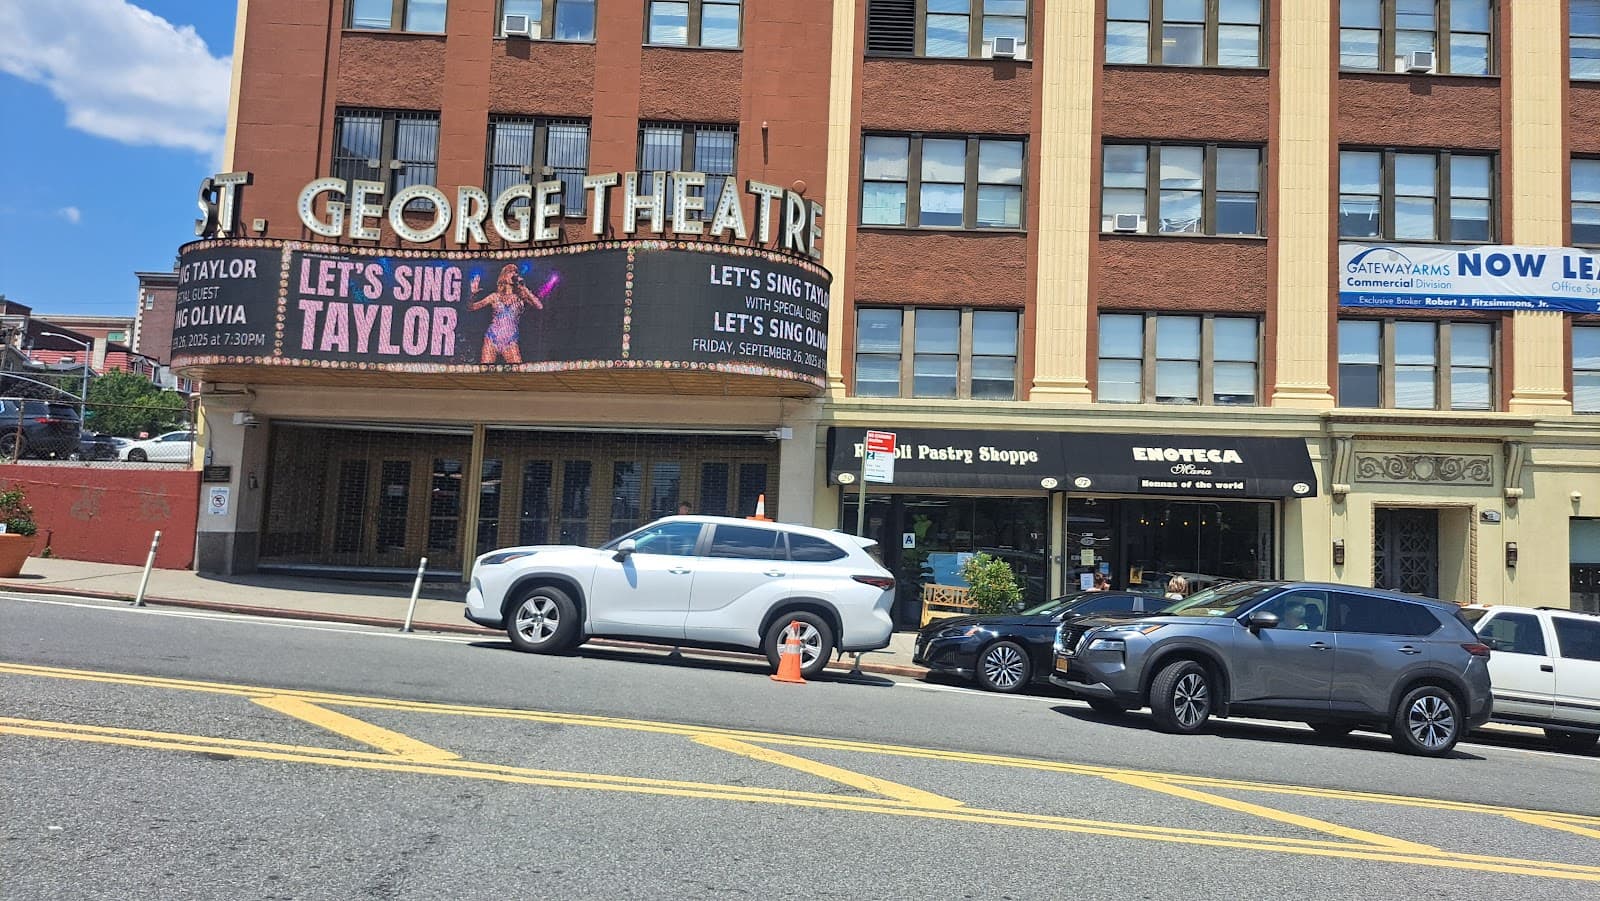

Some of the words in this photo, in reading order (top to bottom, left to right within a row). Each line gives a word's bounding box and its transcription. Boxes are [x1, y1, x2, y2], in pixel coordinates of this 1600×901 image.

[194, 171, 268, 237] ST.
[297, 177, 564, 244] GEORGE
[584, 171, 824, 260] THEATRE
[193, 259, 257, 280] TAYLOR
[1458, 253, 1547, 278] NOW
[1563, 255, 1600, 280] LE
[299, 258, 384, 299] LET'S
[393, 265, 463, 302] SING
[710, 264, 761, 289] LET'S
[766, 272, 802, 298] SING
[1347, 277, 1414, 288] Commercial
[1416, 279, 1452, 289] Division
[1552, 281, 1582, 292] Office
[1585, 284, 1600, 296] Sp
[193, 286, 220, 301] GUEST
[1359, 296, 1394, 304] Exclusive
[1396, 297, 1422, 305] Broker
[1425, 297, 1458, 306] Robert
[1471, 298, 1535, 309] Fitzsimmons,
[1538, 300, 1550, 308] Jr.
[190, 304, 247, 326] OLIVIA
[745, 296, 771, 311] WITH
[773, 300, 805, 319] SPECIAL
[298, 299, 458, 356] TAYLOR
[714, 312, 764, 336] LET'S
[769, 319, 803, 342] SING
[188, 334, 209, 347] 2025
[210, 334, 221, 346] at
[224, 333, 265, 346] 7:30PM
[692, 338, 736, 355] FRIDAY,
[739, 342, 792, 361] SEPTEMBER
[854, 443, 912, 459] Roli
[918, 444, 973, 464] Pastry
[979, 446, 1039, 466] Shoppe
[1132, 447, 1244, 464] ENOTECA
[1180, 480, 1193, 488] of
[1195, 481, 1213, 489] the
[1215, 482, 1244, 490] world
[905, 535, 913, 544] A
